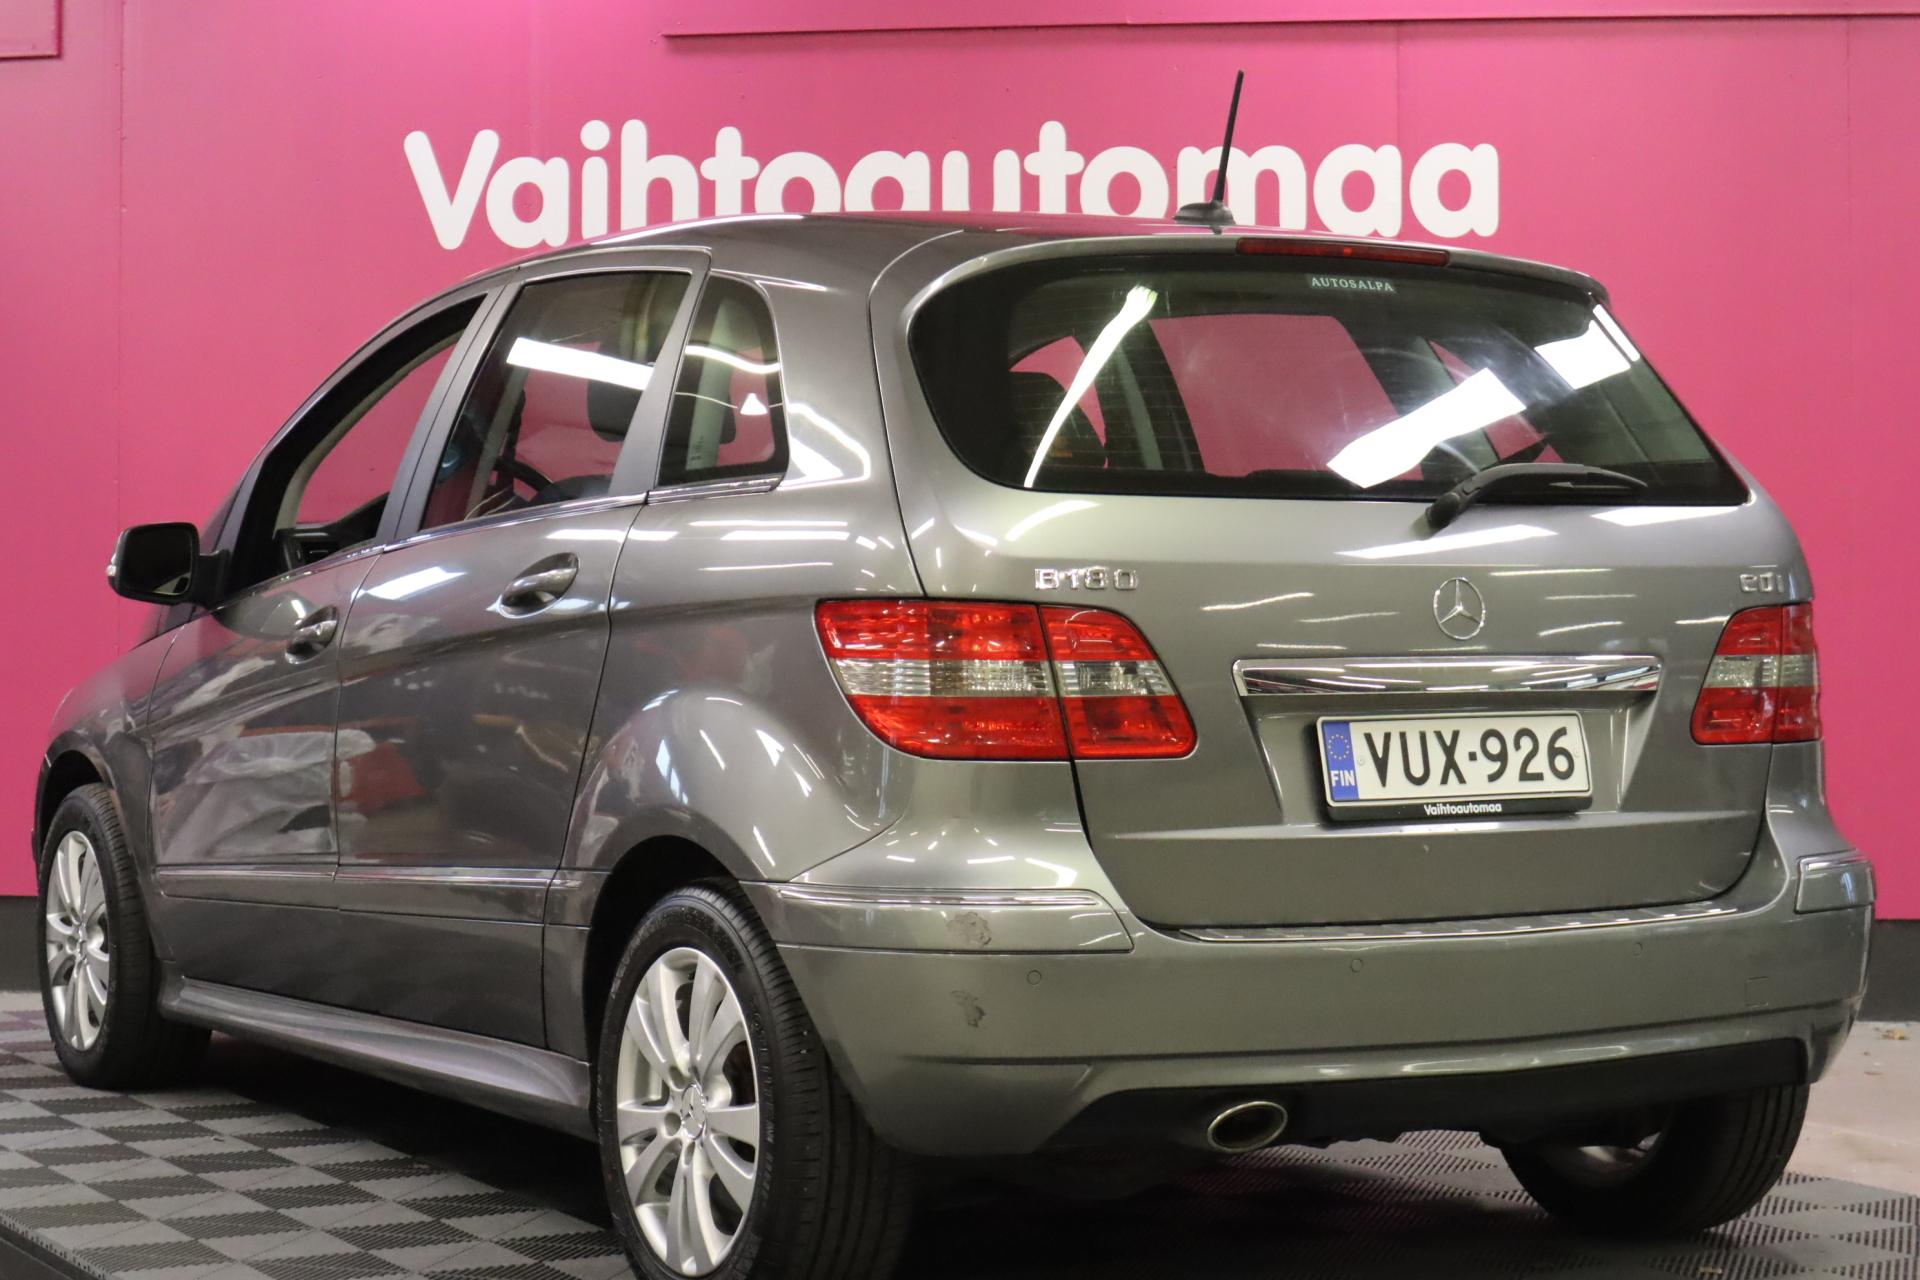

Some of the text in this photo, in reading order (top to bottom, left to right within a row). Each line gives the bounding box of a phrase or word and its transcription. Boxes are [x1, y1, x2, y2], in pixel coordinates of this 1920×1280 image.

[403, 118, 1500, 250] Vaihtoautomaa
[1311, 277, 1395, 292] AUTOSALPA
[1330, 770, 1356, 787] FIN
[1423, 802, 1502, 816] Vaihtoautomaa
